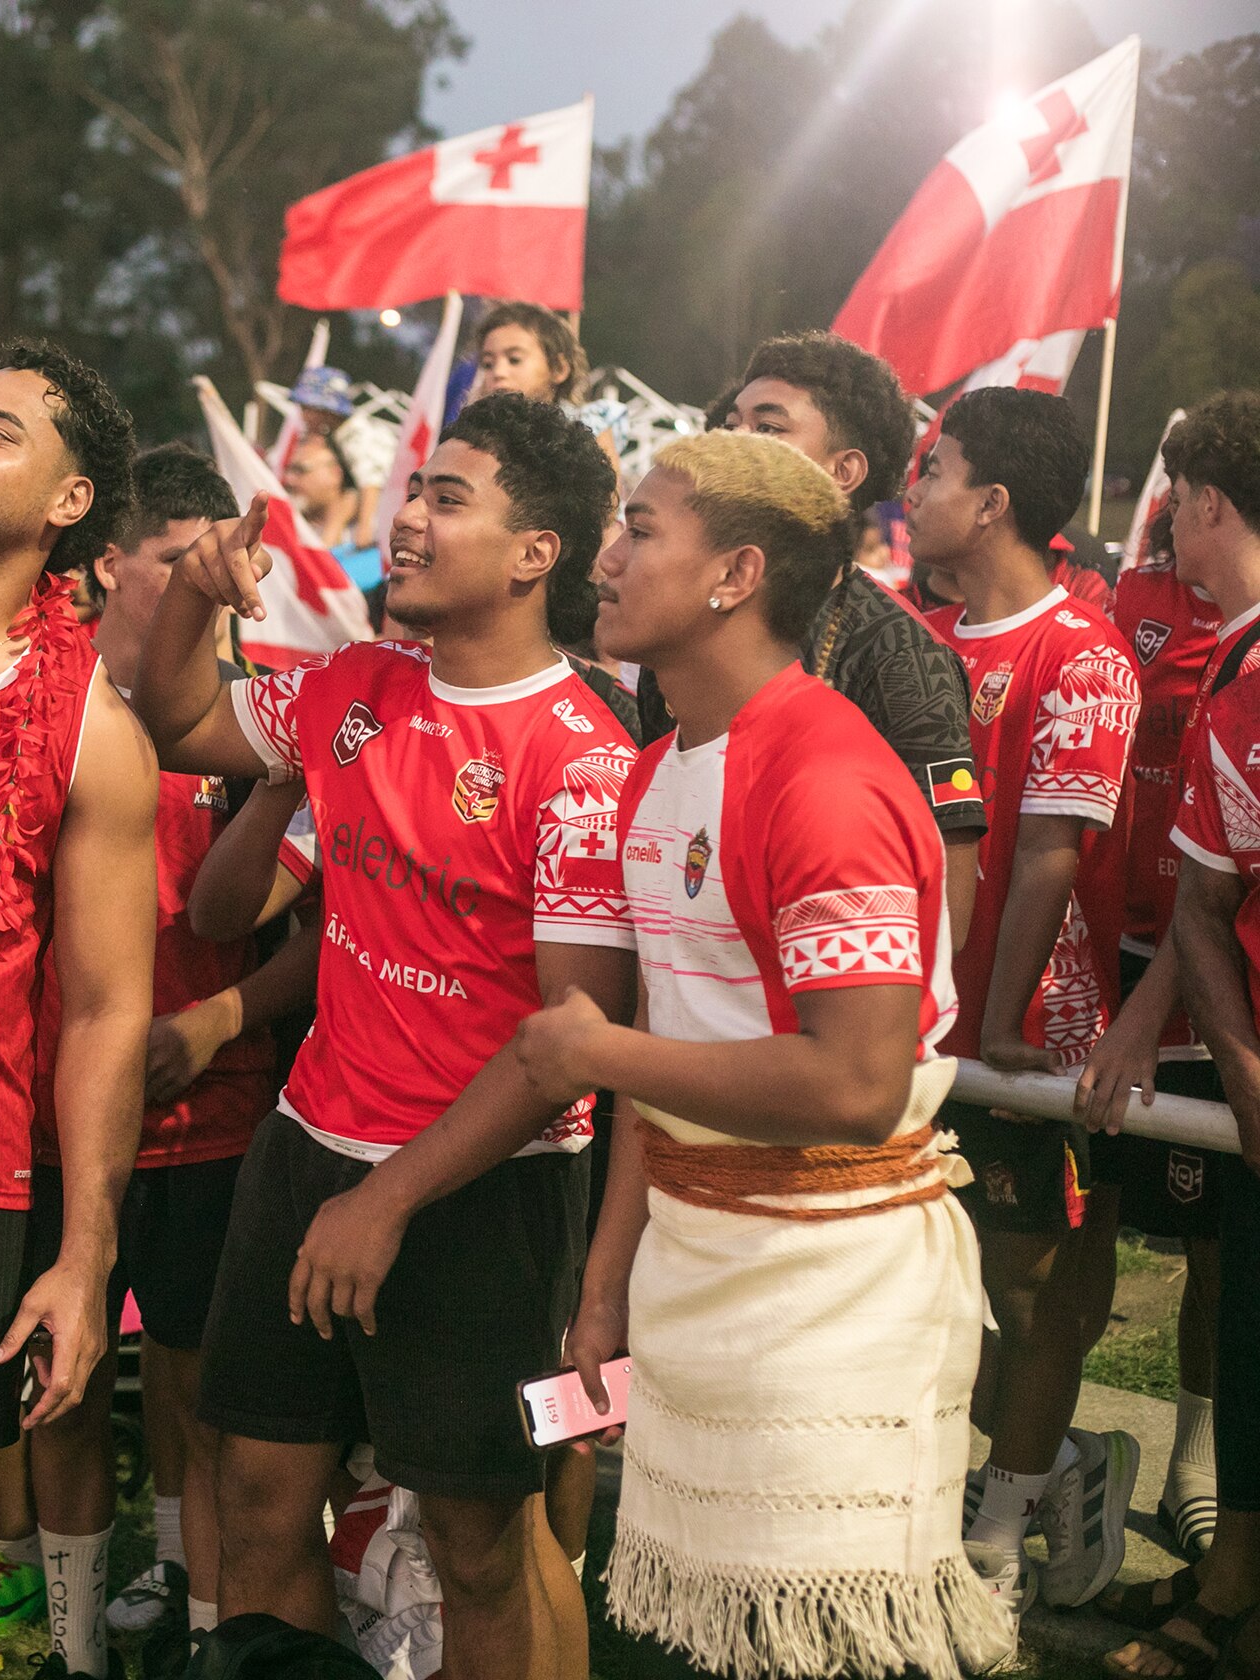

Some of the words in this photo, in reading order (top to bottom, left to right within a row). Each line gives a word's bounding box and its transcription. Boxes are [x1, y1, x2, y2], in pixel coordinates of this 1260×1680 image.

[378, 958, 468, 1000] MEDIA
[48, 1550, 69, 1659] TONGA
[356, 1611, 385, 1638] MEDI
